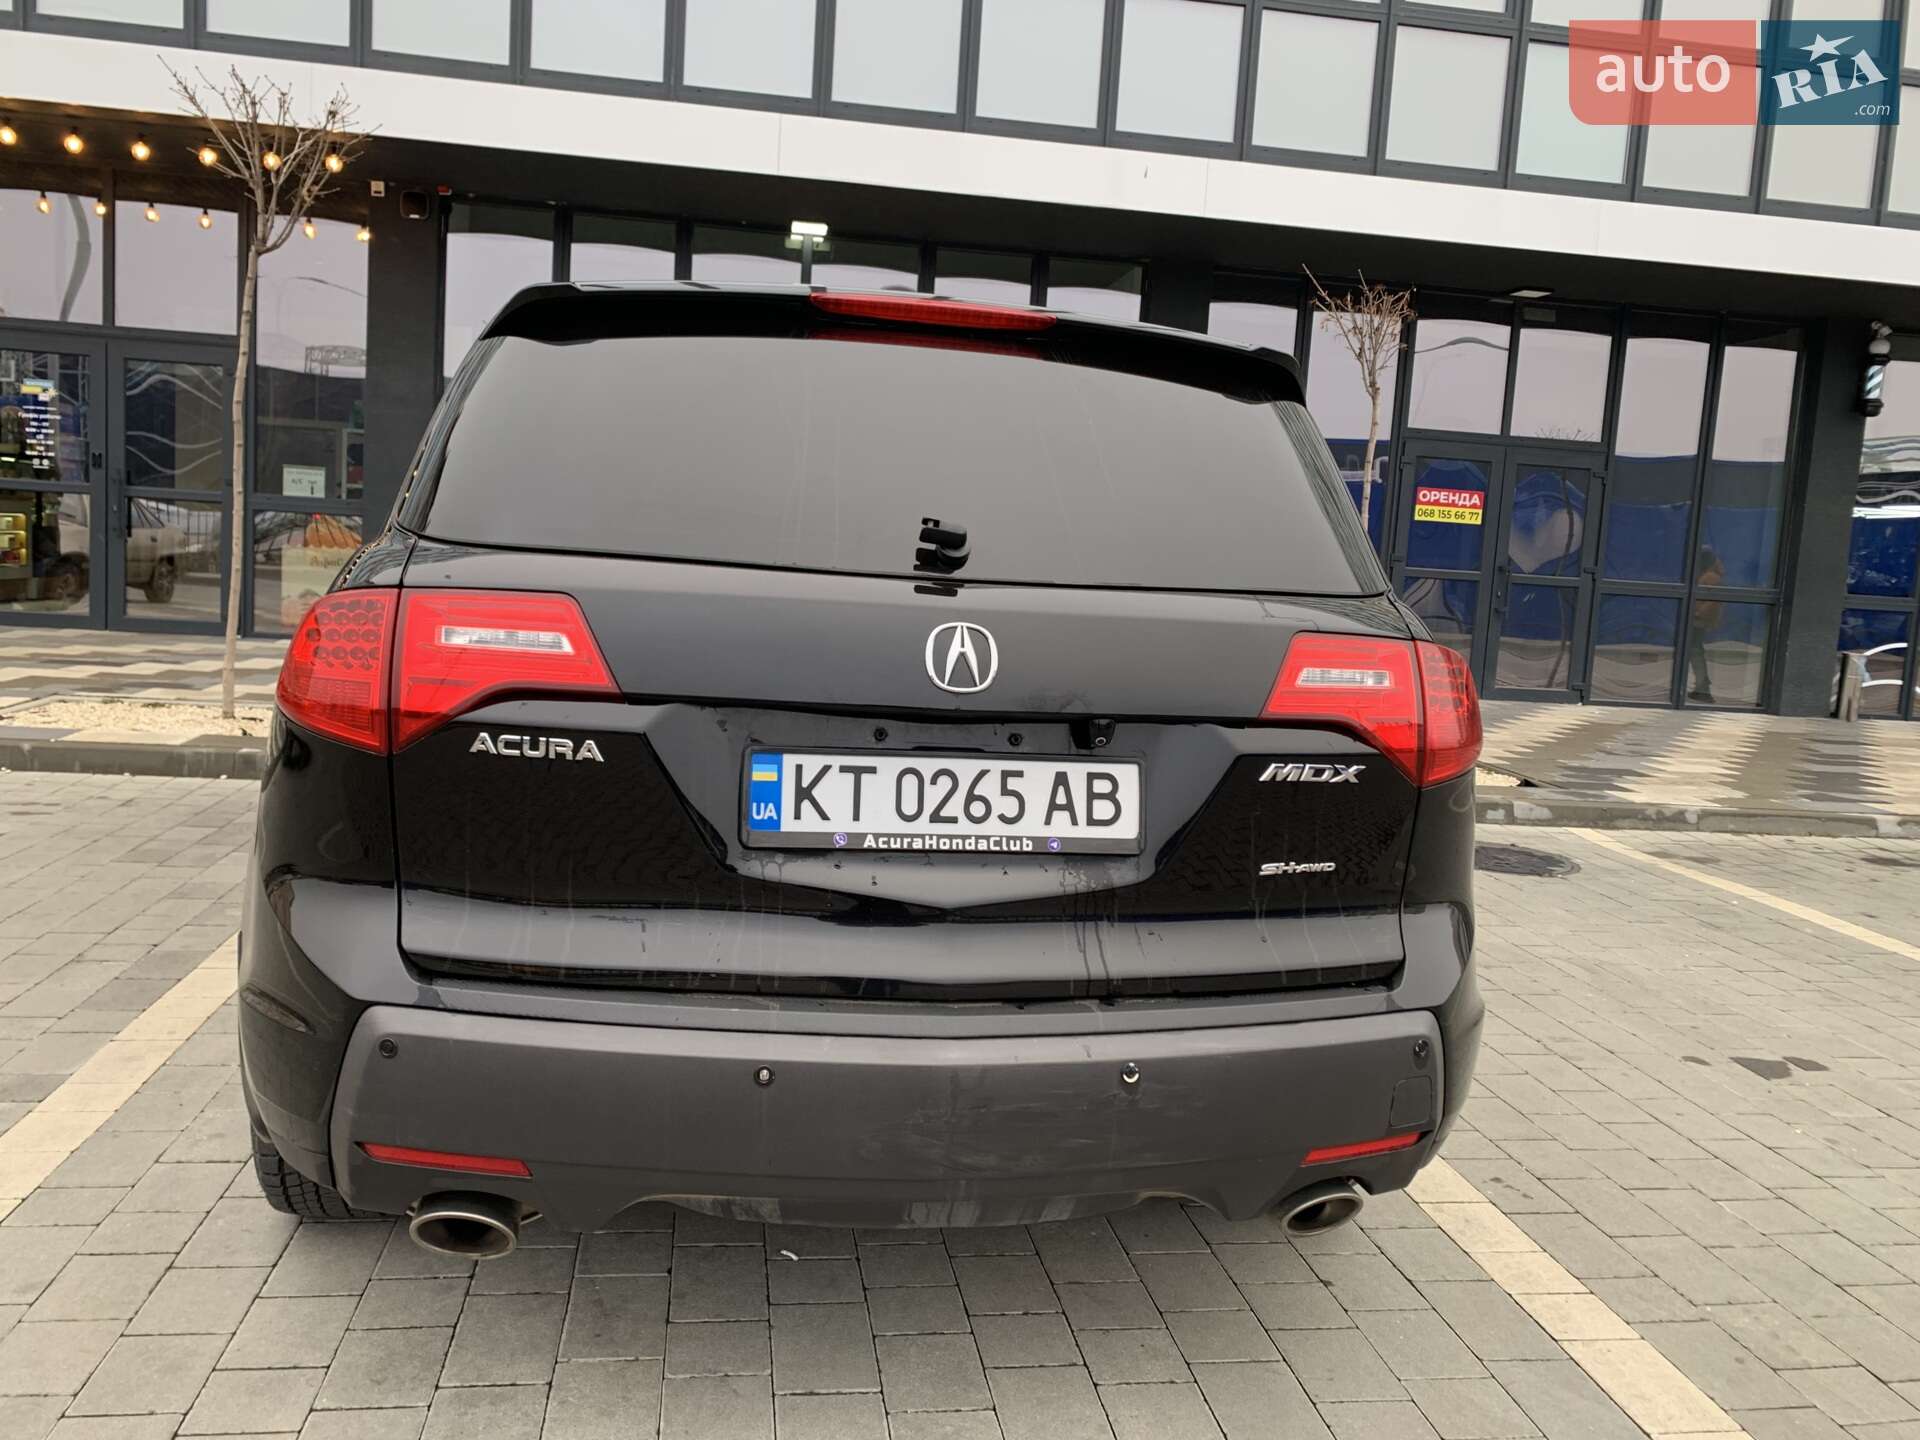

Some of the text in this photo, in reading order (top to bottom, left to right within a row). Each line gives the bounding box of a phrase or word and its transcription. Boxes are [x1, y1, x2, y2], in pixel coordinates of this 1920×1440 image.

[1419, 490, 1481, 507] ОРЕНДА
[1417, 508, 1480, 521] 068 155 66 77
[469, 732, 605, 762] ACURA
[1258, 763, 1367, 783] MDX
[793, 763, 1122, 827] KT 0265 AB
[752, 802, 778, 820] UA
[863, 833, 1033, 851] AcuraHondaClub
